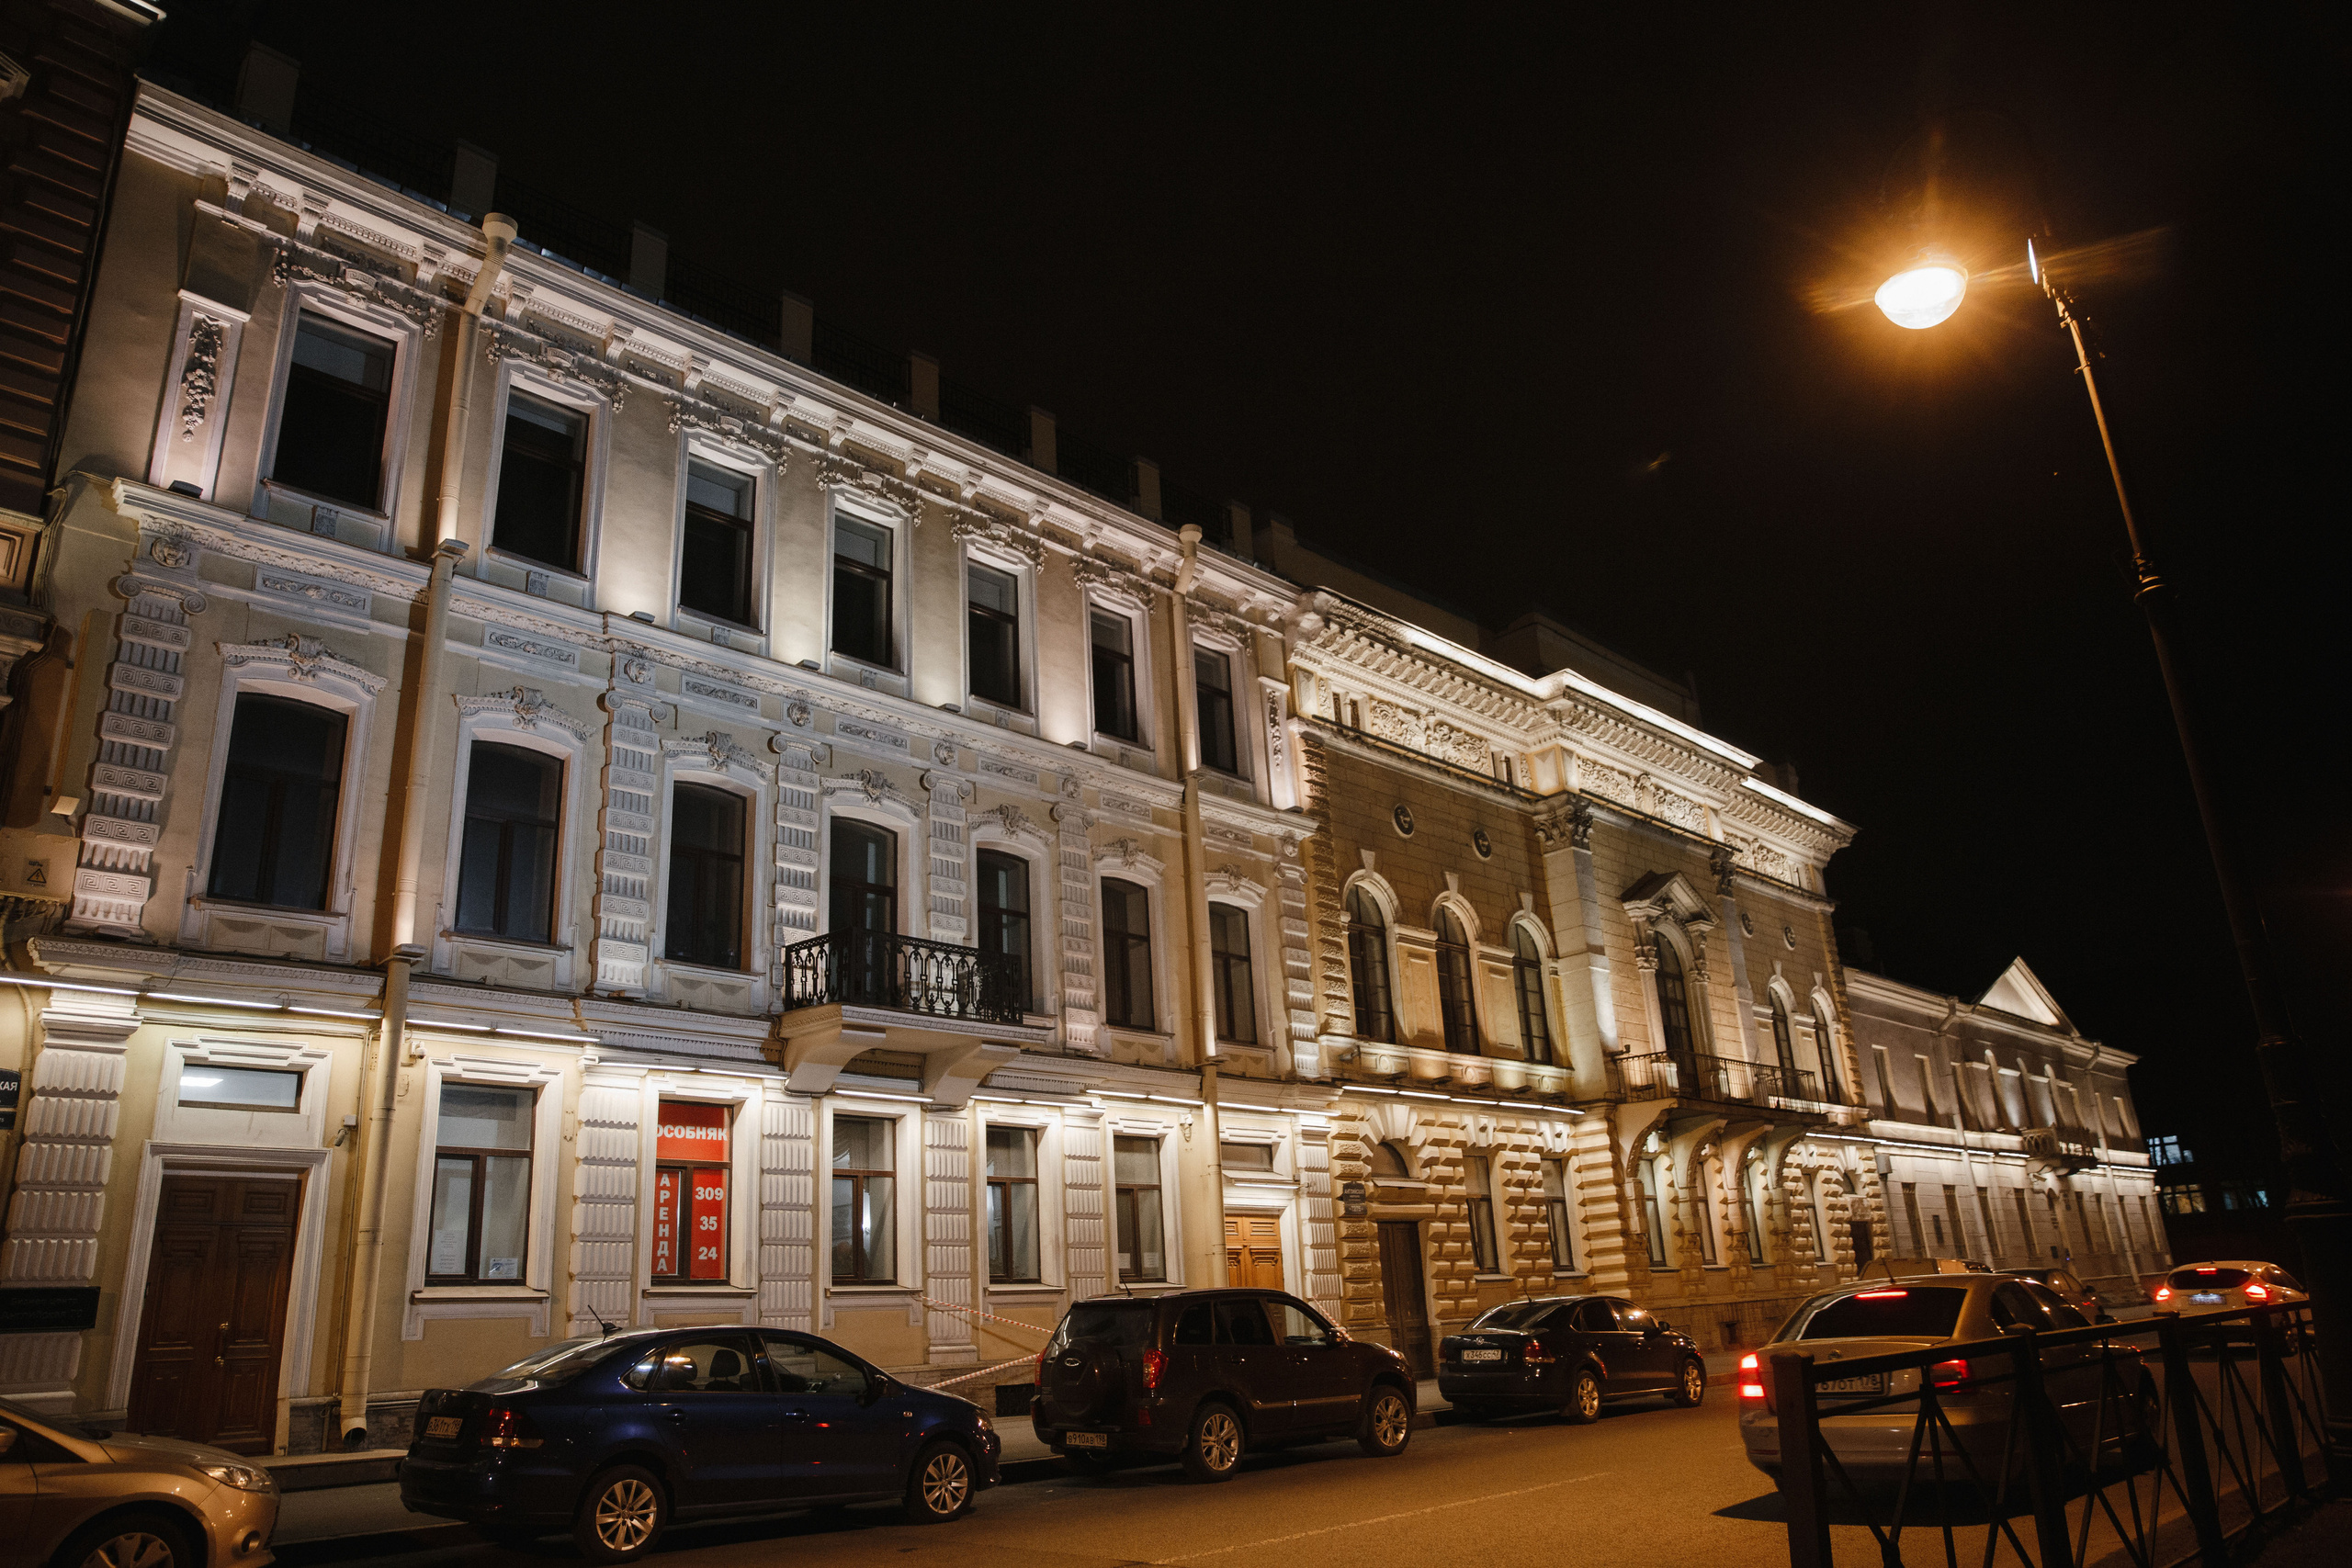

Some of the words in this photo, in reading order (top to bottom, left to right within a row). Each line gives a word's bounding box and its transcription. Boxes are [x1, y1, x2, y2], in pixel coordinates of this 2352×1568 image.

[656, 1123, 729, 1141] ОСОБНЯК
[695, 1186, 724, 1201] 309
[656, 1173, 671, 1273] АРЕНДА
[699, 1215, 718, 1232] 35
[697, 1246, 718, 1261] 24
